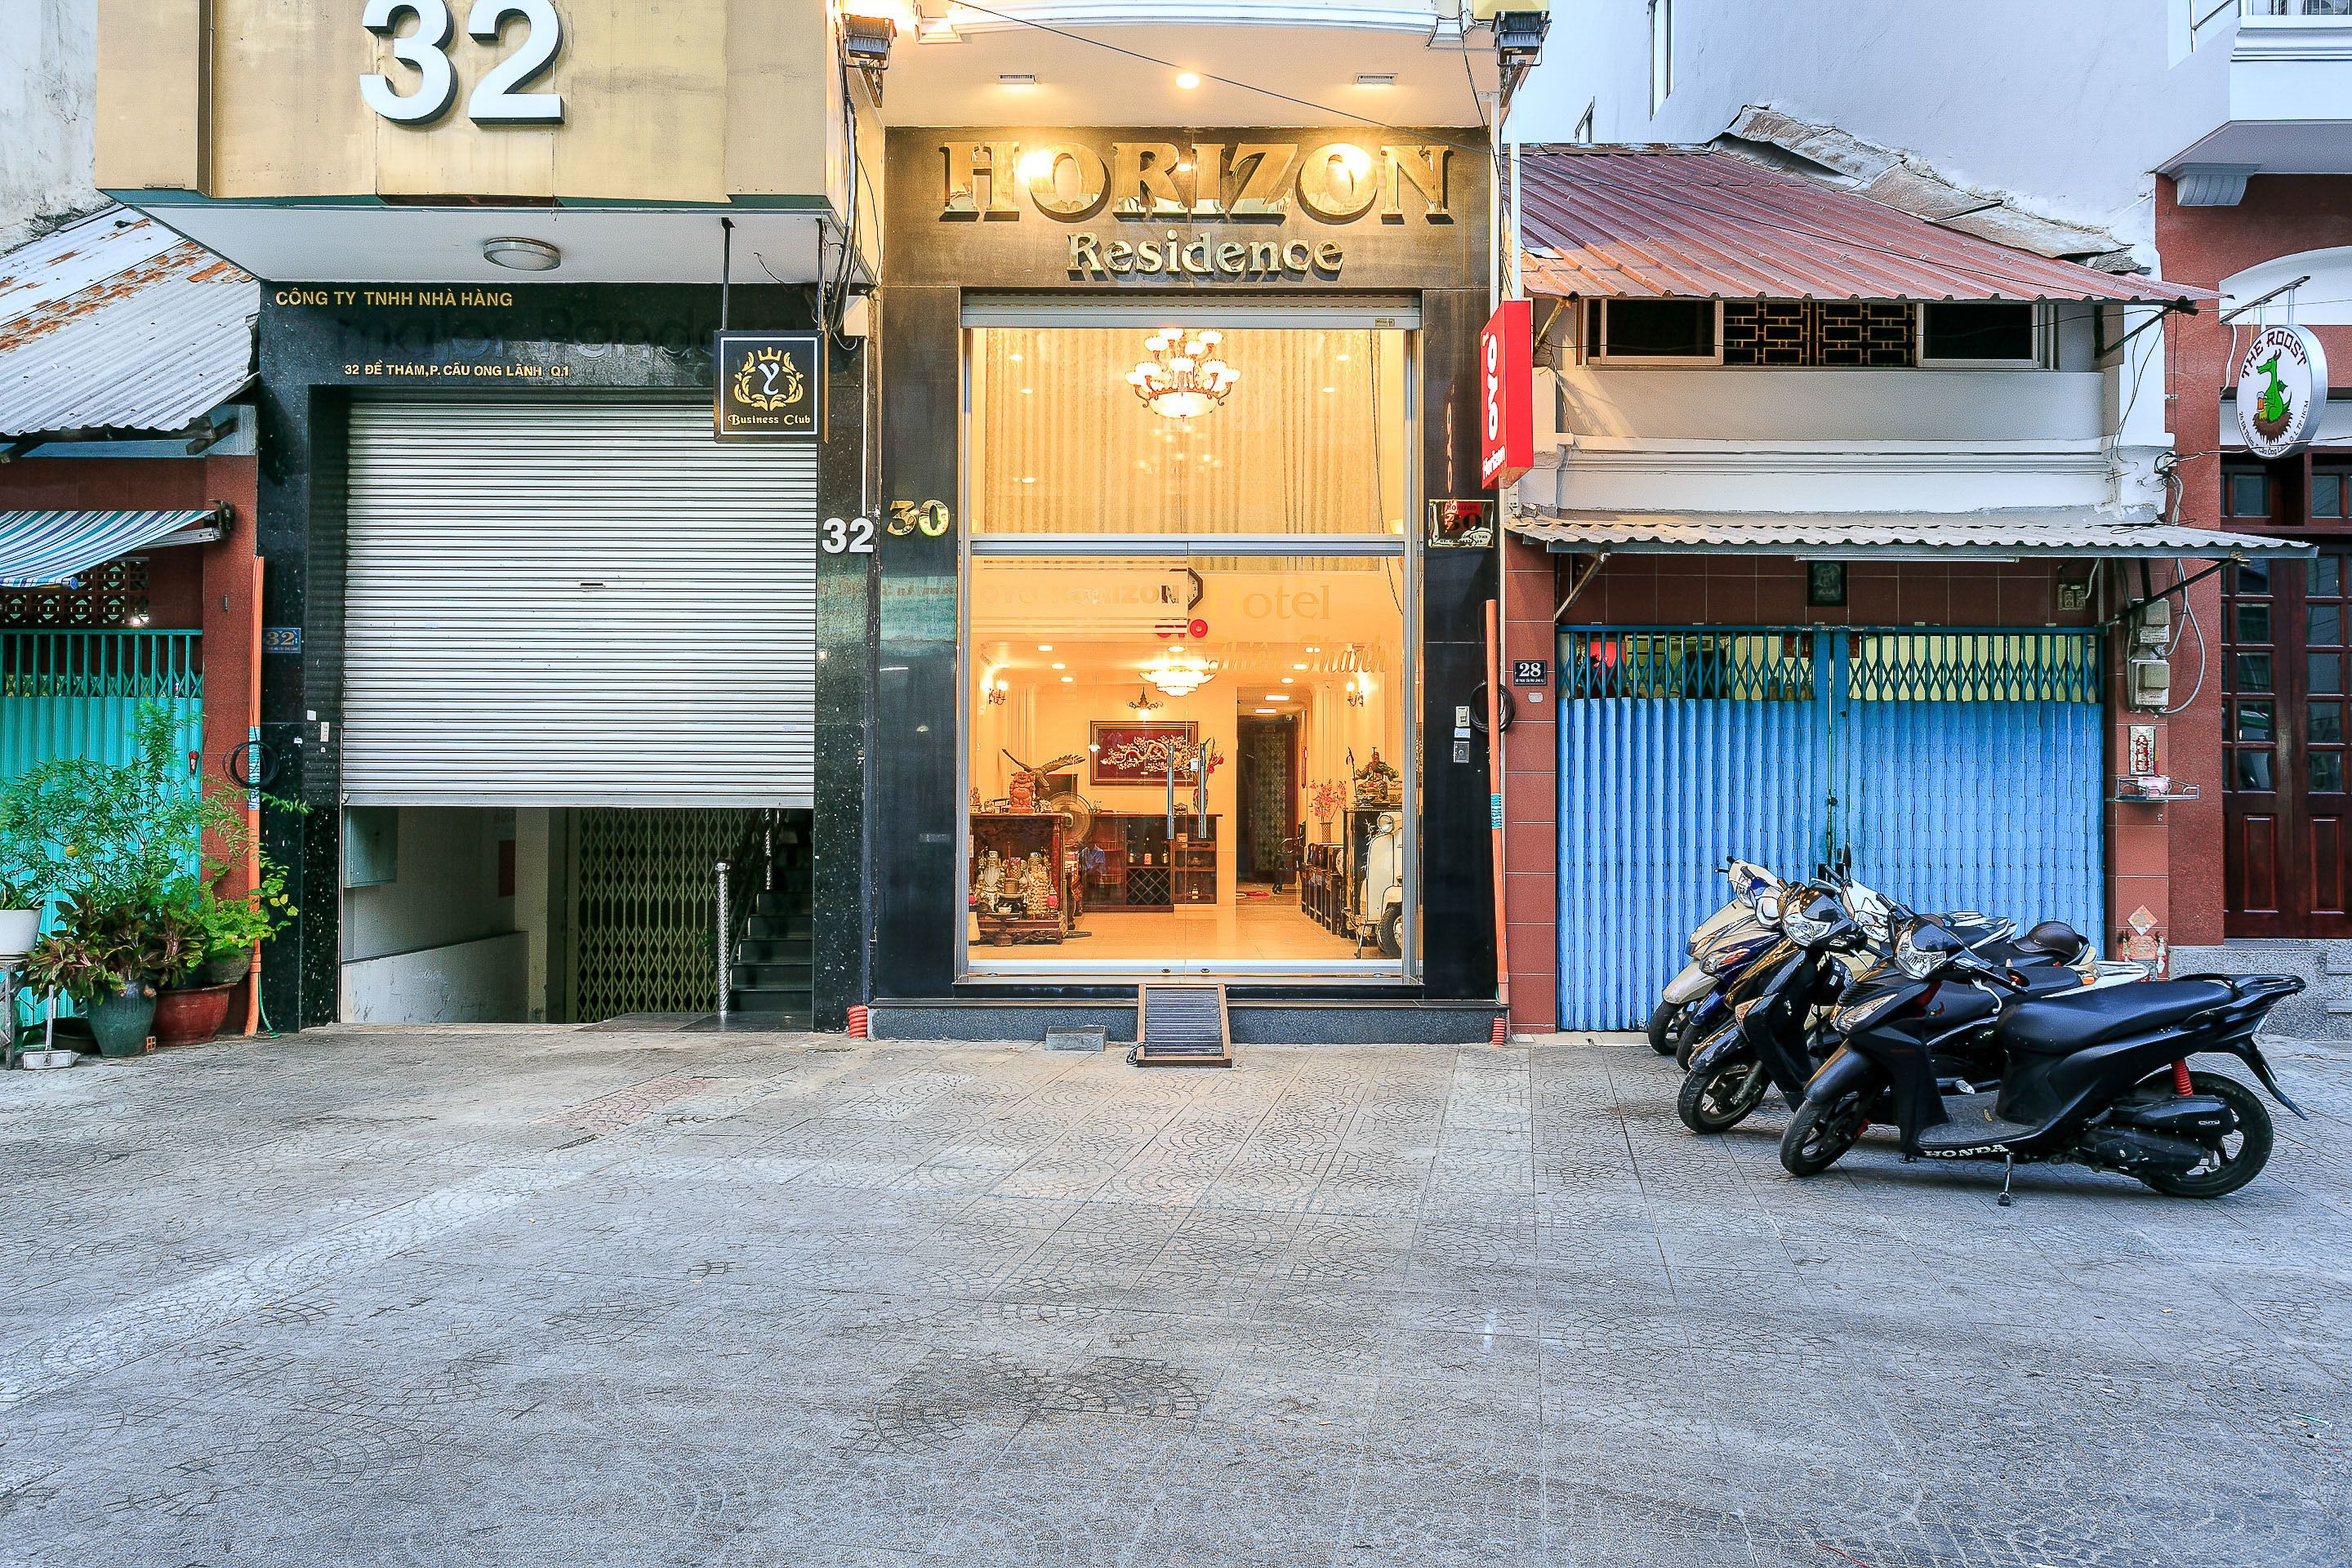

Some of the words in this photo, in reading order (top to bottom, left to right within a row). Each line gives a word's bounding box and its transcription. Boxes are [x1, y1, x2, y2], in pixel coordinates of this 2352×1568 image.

[359, 0, 565, 125] 32
[939, 142, 1452, 220] HORIZON
[1067, 229, 1344, 278] Residence
[275, 287, 328, 305] CÔNG
[334, 292, 356, 305] TY
[364, 292, 413, 305] TNHH
[419, 288, 457, 306] NHÀ
[461, 288, 513, 306] HÀNG
[344, 364, 360, 375] 32
[365, 359, 382, 375] ĐỀ
[506, 364, 542, 376] LÃNH
[550, 365, 569, 376] Q.1
[2242, 340, 2264, 378] THE
[2266, 331, 2307, 365] ROOST
[728, 414, 779, 425] Business
[784, 415, 810, 425] Club
[822, 517, 875, 555] 32
[887, 499, 951, 537] 30
[1519, 662, 1541, 677] 28
[1924, 1144, 2009, 1157] HONDA
